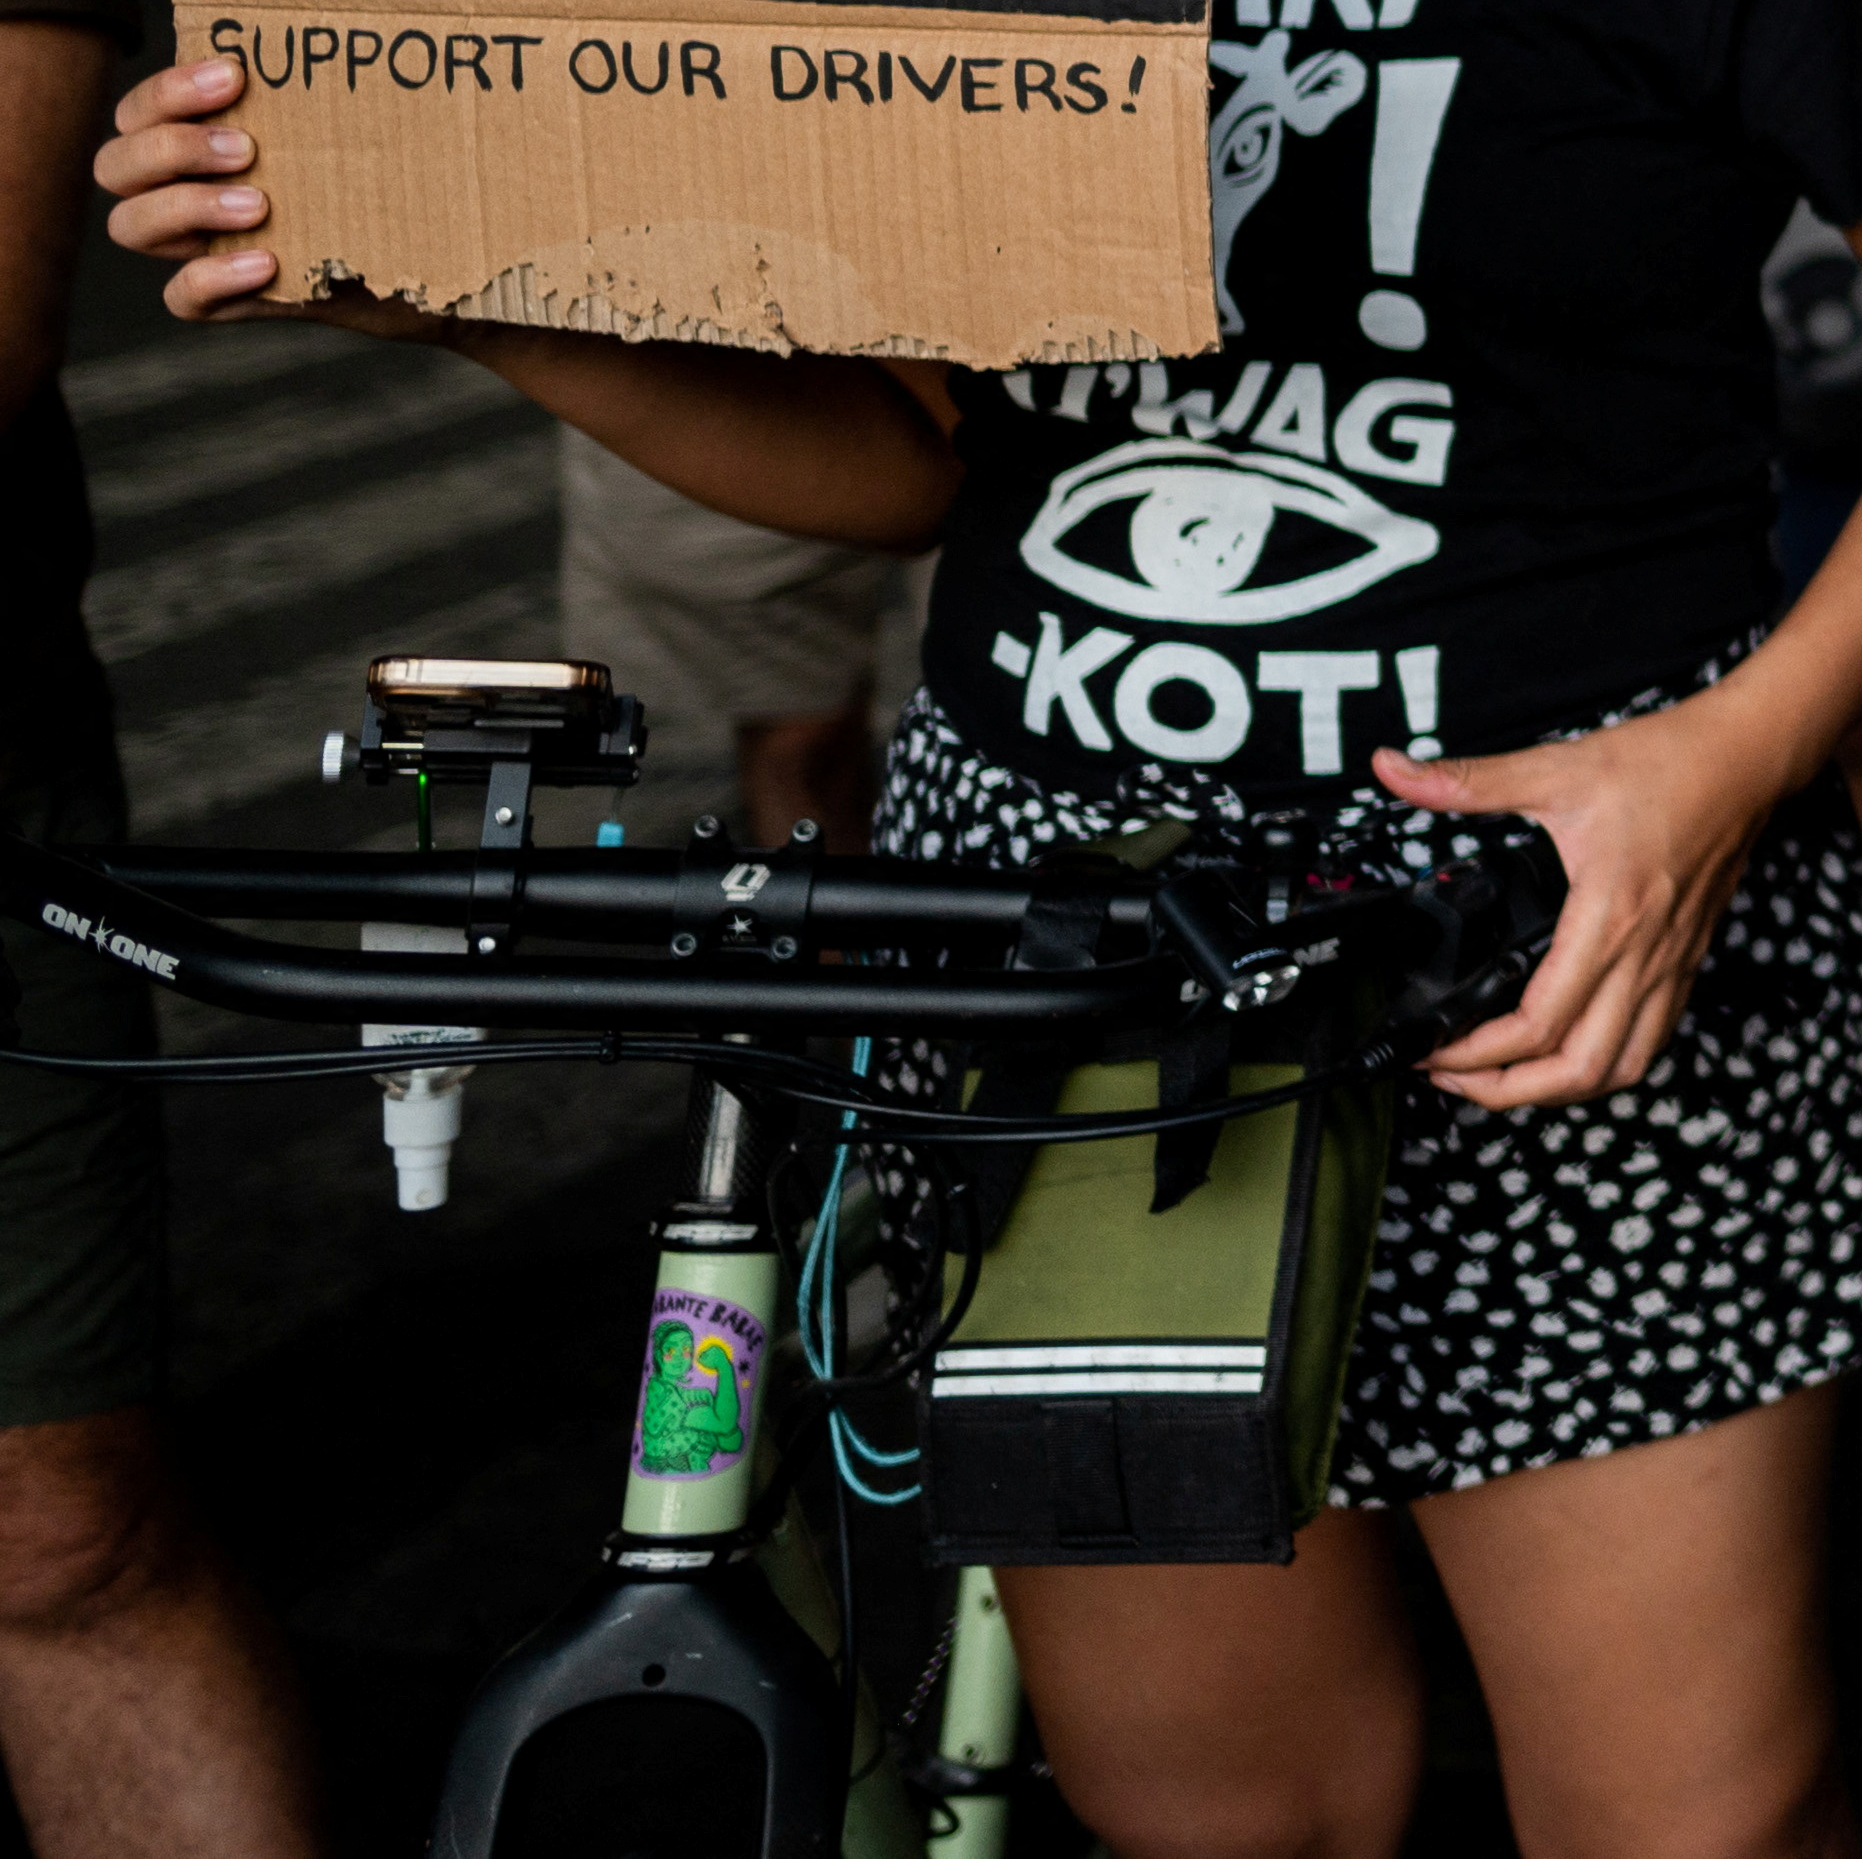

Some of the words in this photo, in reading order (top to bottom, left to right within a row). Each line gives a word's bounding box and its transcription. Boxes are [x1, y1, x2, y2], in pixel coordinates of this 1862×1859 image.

[208, 18, 544, 93] SUPPORT
[568, 38, 727, 102] OUR
[770, 44, 1148, 116] DRIVERS!
